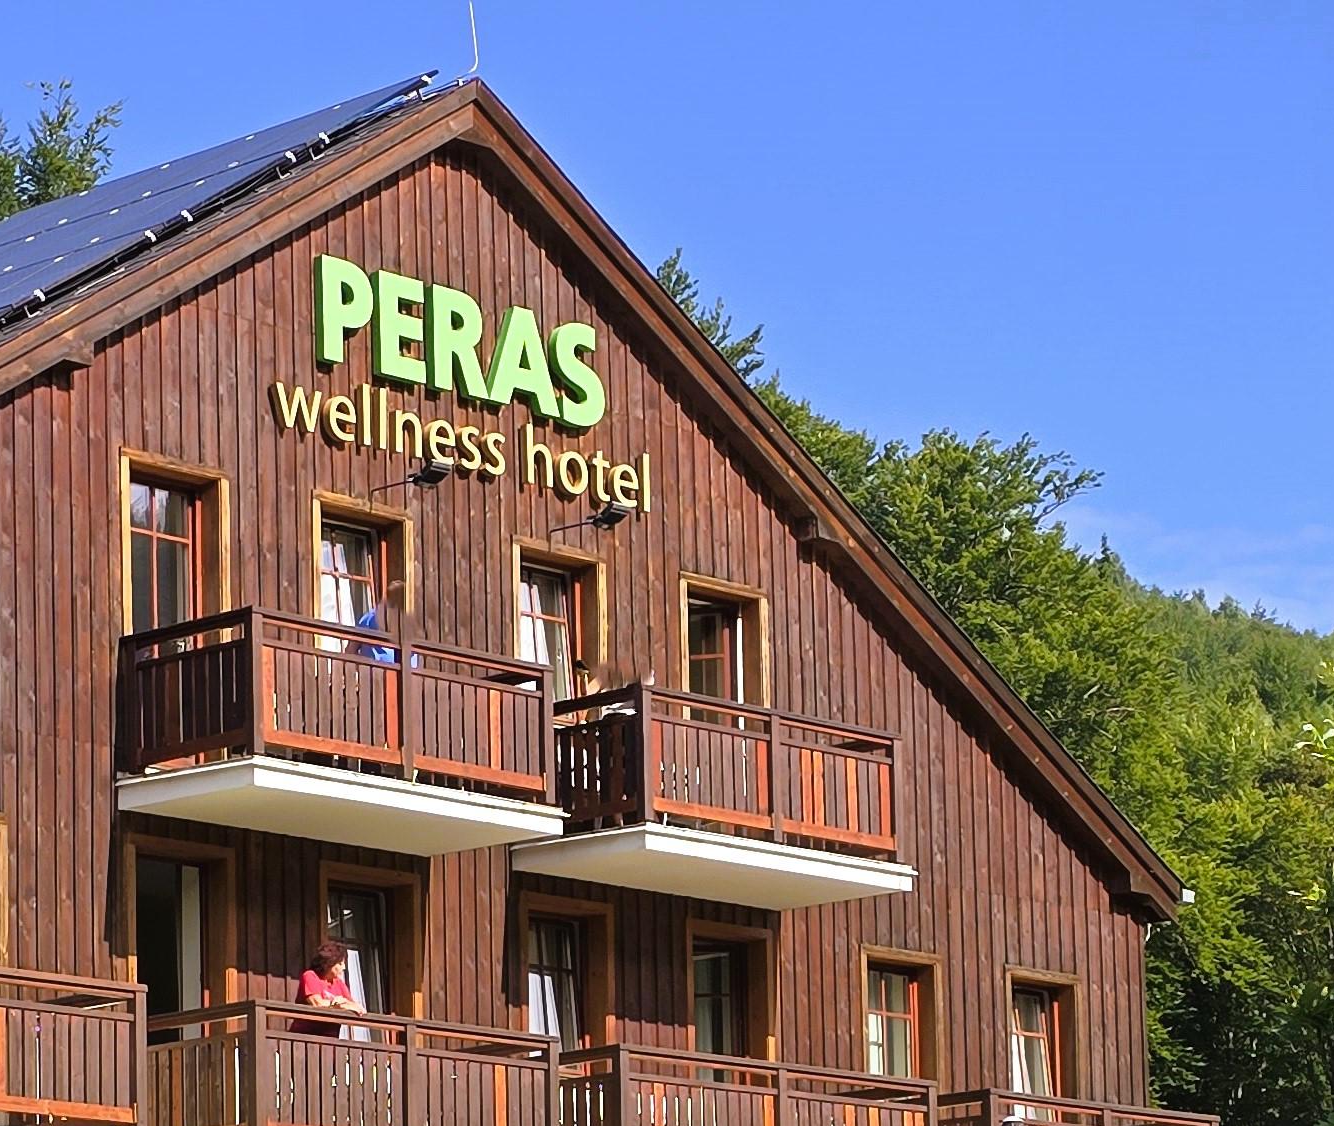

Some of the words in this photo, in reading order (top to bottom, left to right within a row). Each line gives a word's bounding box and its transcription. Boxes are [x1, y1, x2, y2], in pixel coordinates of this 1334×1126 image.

[315, 254, 606, 427] PERAS
[271, 381, 506, 477] wellness
[523, 422, 651, 513] hotel
